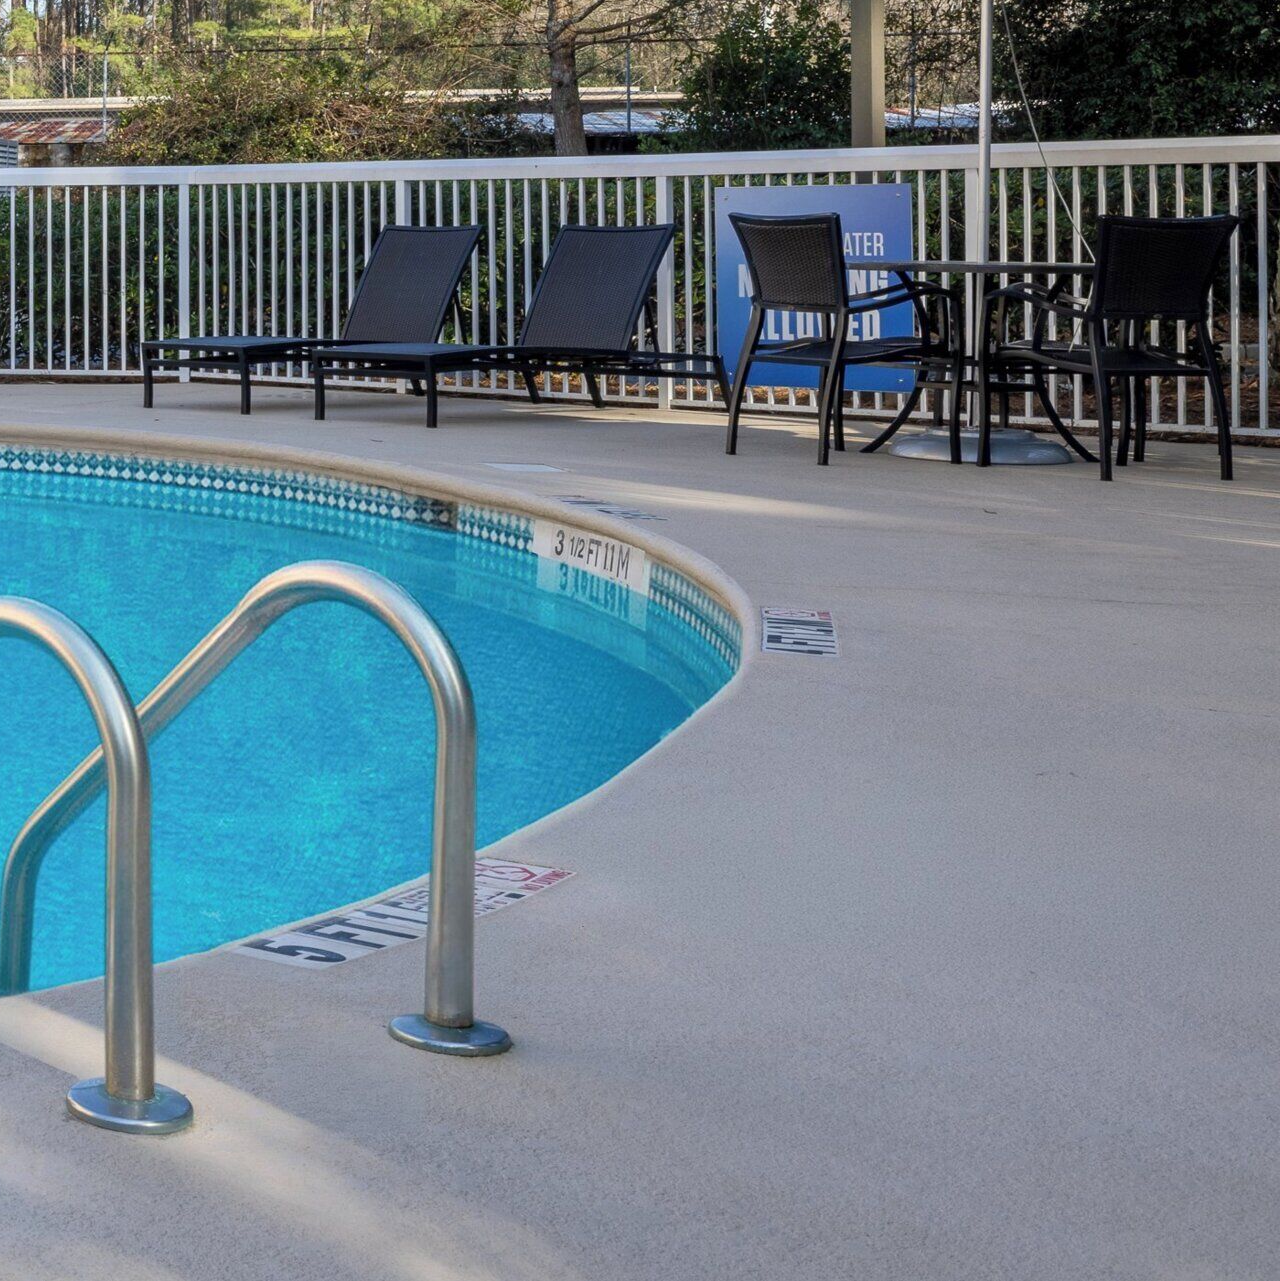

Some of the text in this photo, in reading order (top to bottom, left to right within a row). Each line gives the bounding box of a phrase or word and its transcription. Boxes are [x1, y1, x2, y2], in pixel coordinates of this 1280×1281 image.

[843, 232, 885, 257] ATER
[555, 529, 565, 556] 3
[570, 536, 585, 559] 1/2
[586, 538, 602, 567] FT
[616, 544, 630, 579] M
[241, 938, 346, 963] 5
